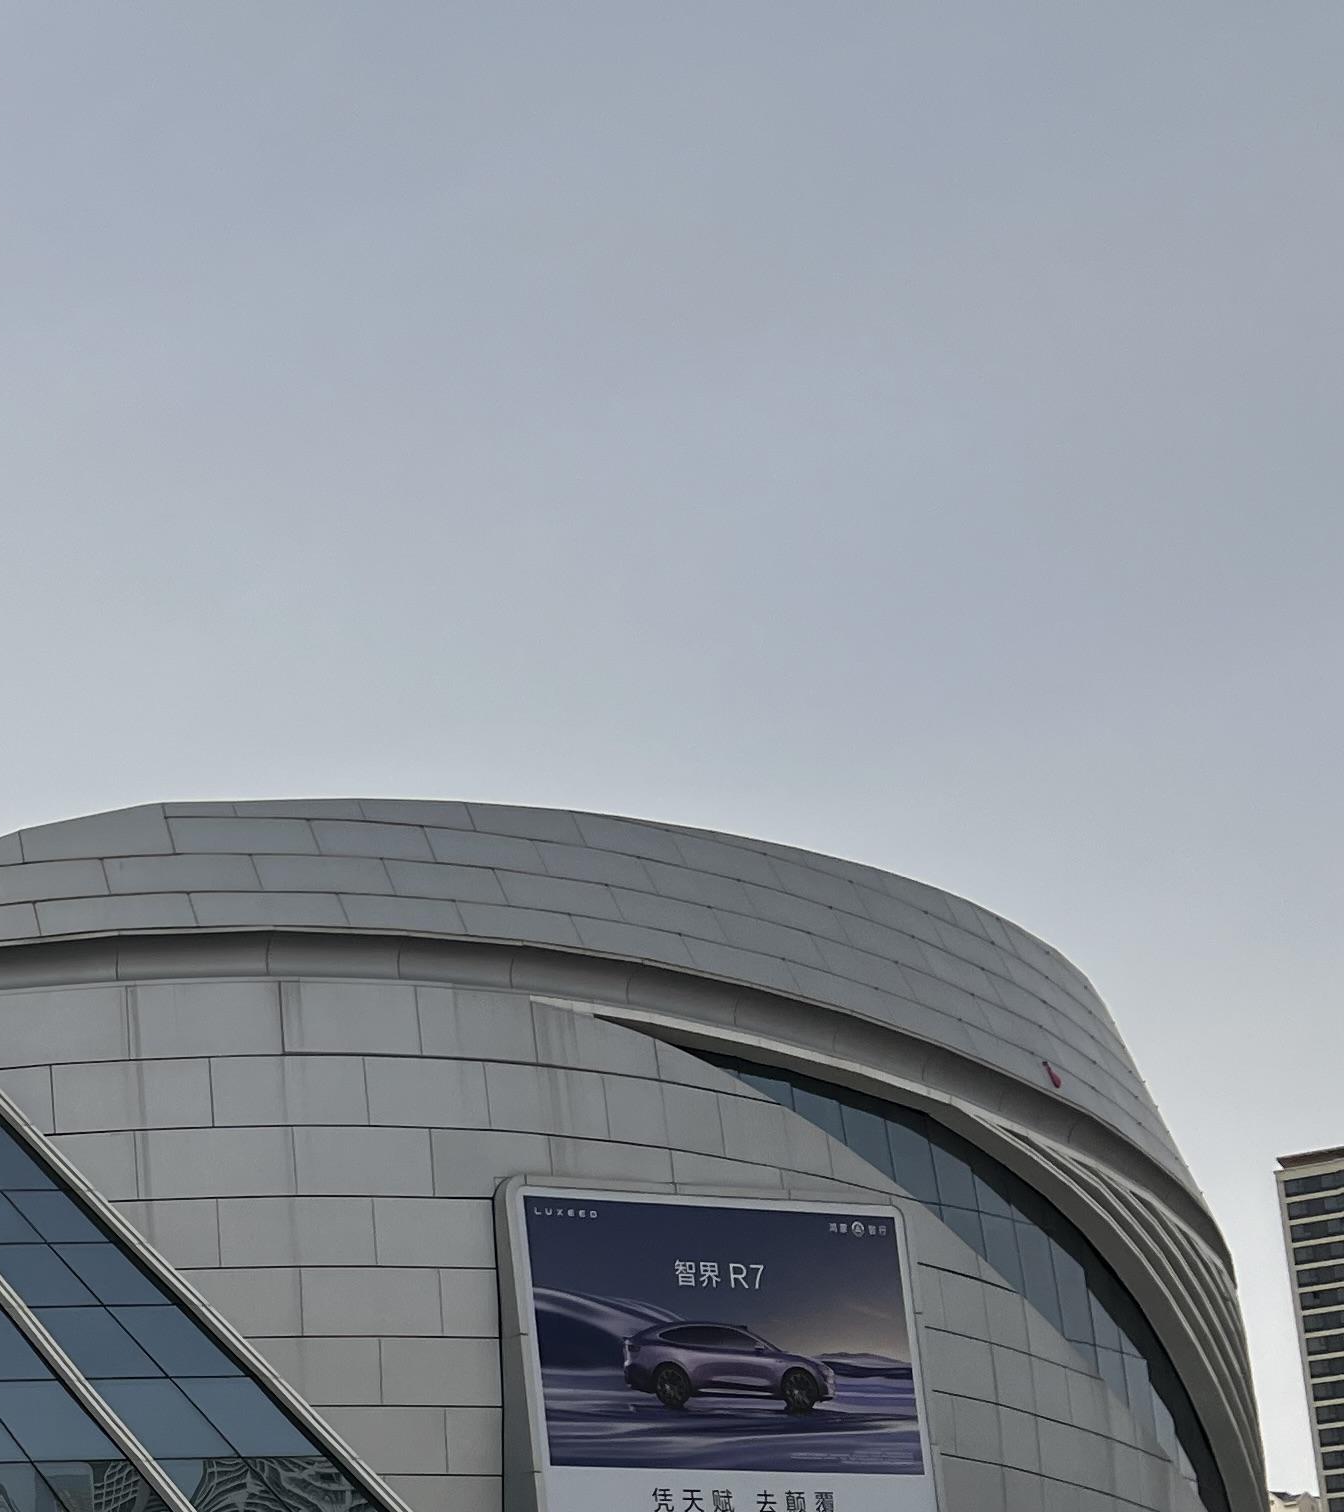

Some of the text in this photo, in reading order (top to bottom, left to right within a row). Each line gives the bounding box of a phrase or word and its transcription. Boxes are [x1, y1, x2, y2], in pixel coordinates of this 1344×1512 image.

[533, 1206, 599, 1218] LUXEED
[674, 1259, 766, 1289] 智界 R7
